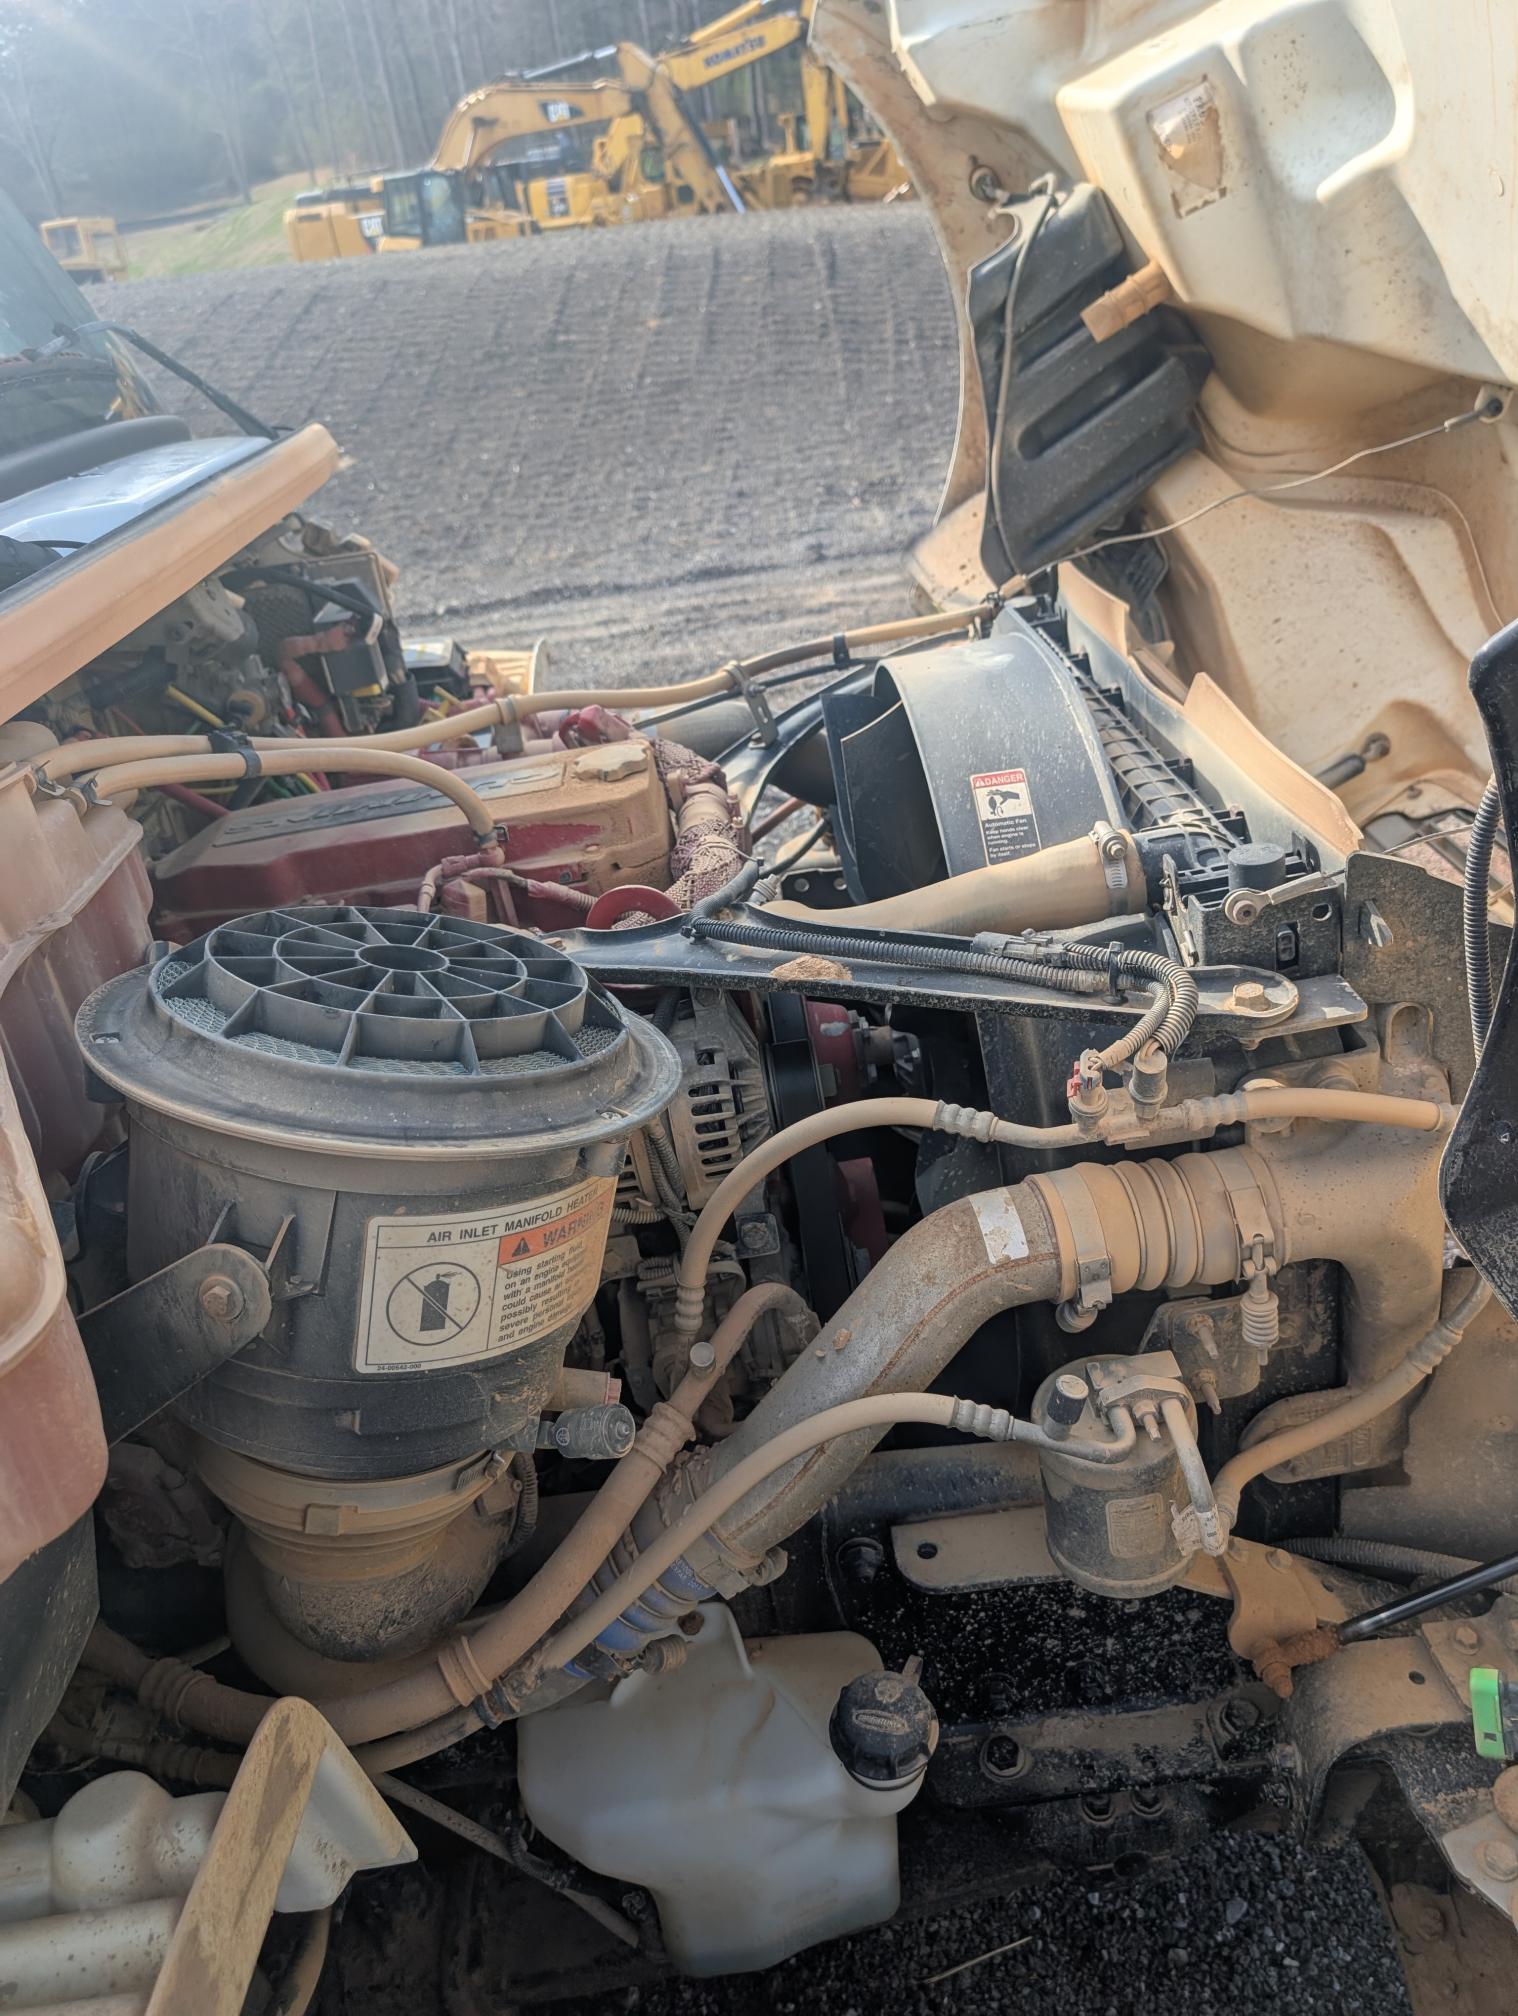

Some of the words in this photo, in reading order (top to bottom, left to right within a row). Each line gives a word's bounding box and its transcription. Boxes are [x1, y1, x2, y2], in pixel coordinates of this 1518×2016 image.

[985, 773, 1024, 785] DANGER
[985, 820, 1015, 828] Automatic
[427, 1231, 452, 1243] AIR
[460, 1224, 498, 1240] INLET
[504, 1206, 563, 1233] MANIFOLD
[566, 1187, 599, 1212] HEATER
[543, 1201, 604, 1248] WARNING
[505, 1282, 516, 1290] on
[520, 1277, 531, 1286] an
[535, 1265, 560, 1279] engine
[506, 1266, 532, 1280] Using
[537, 1252, 566, 1270] starting
[502, 1297, 526, 1311] could
[530, 1287, 552, 1302] cause
[554, 1281, 563, 1291] an
[503, 1290, 521, 1301] with
[525, 1286, 531, 1294] a
[534, 1269, 565, 1291] manifold
[499, 1316, 529, 1332] severe
[533, 1298, 564, 1321] personal
[500, 1303, 538, 1323] possibly
[541, 1287, 571, 1307] resulting
[498, 1330, 515, 1343] and
[518, 1319, 545, 1336] engine
